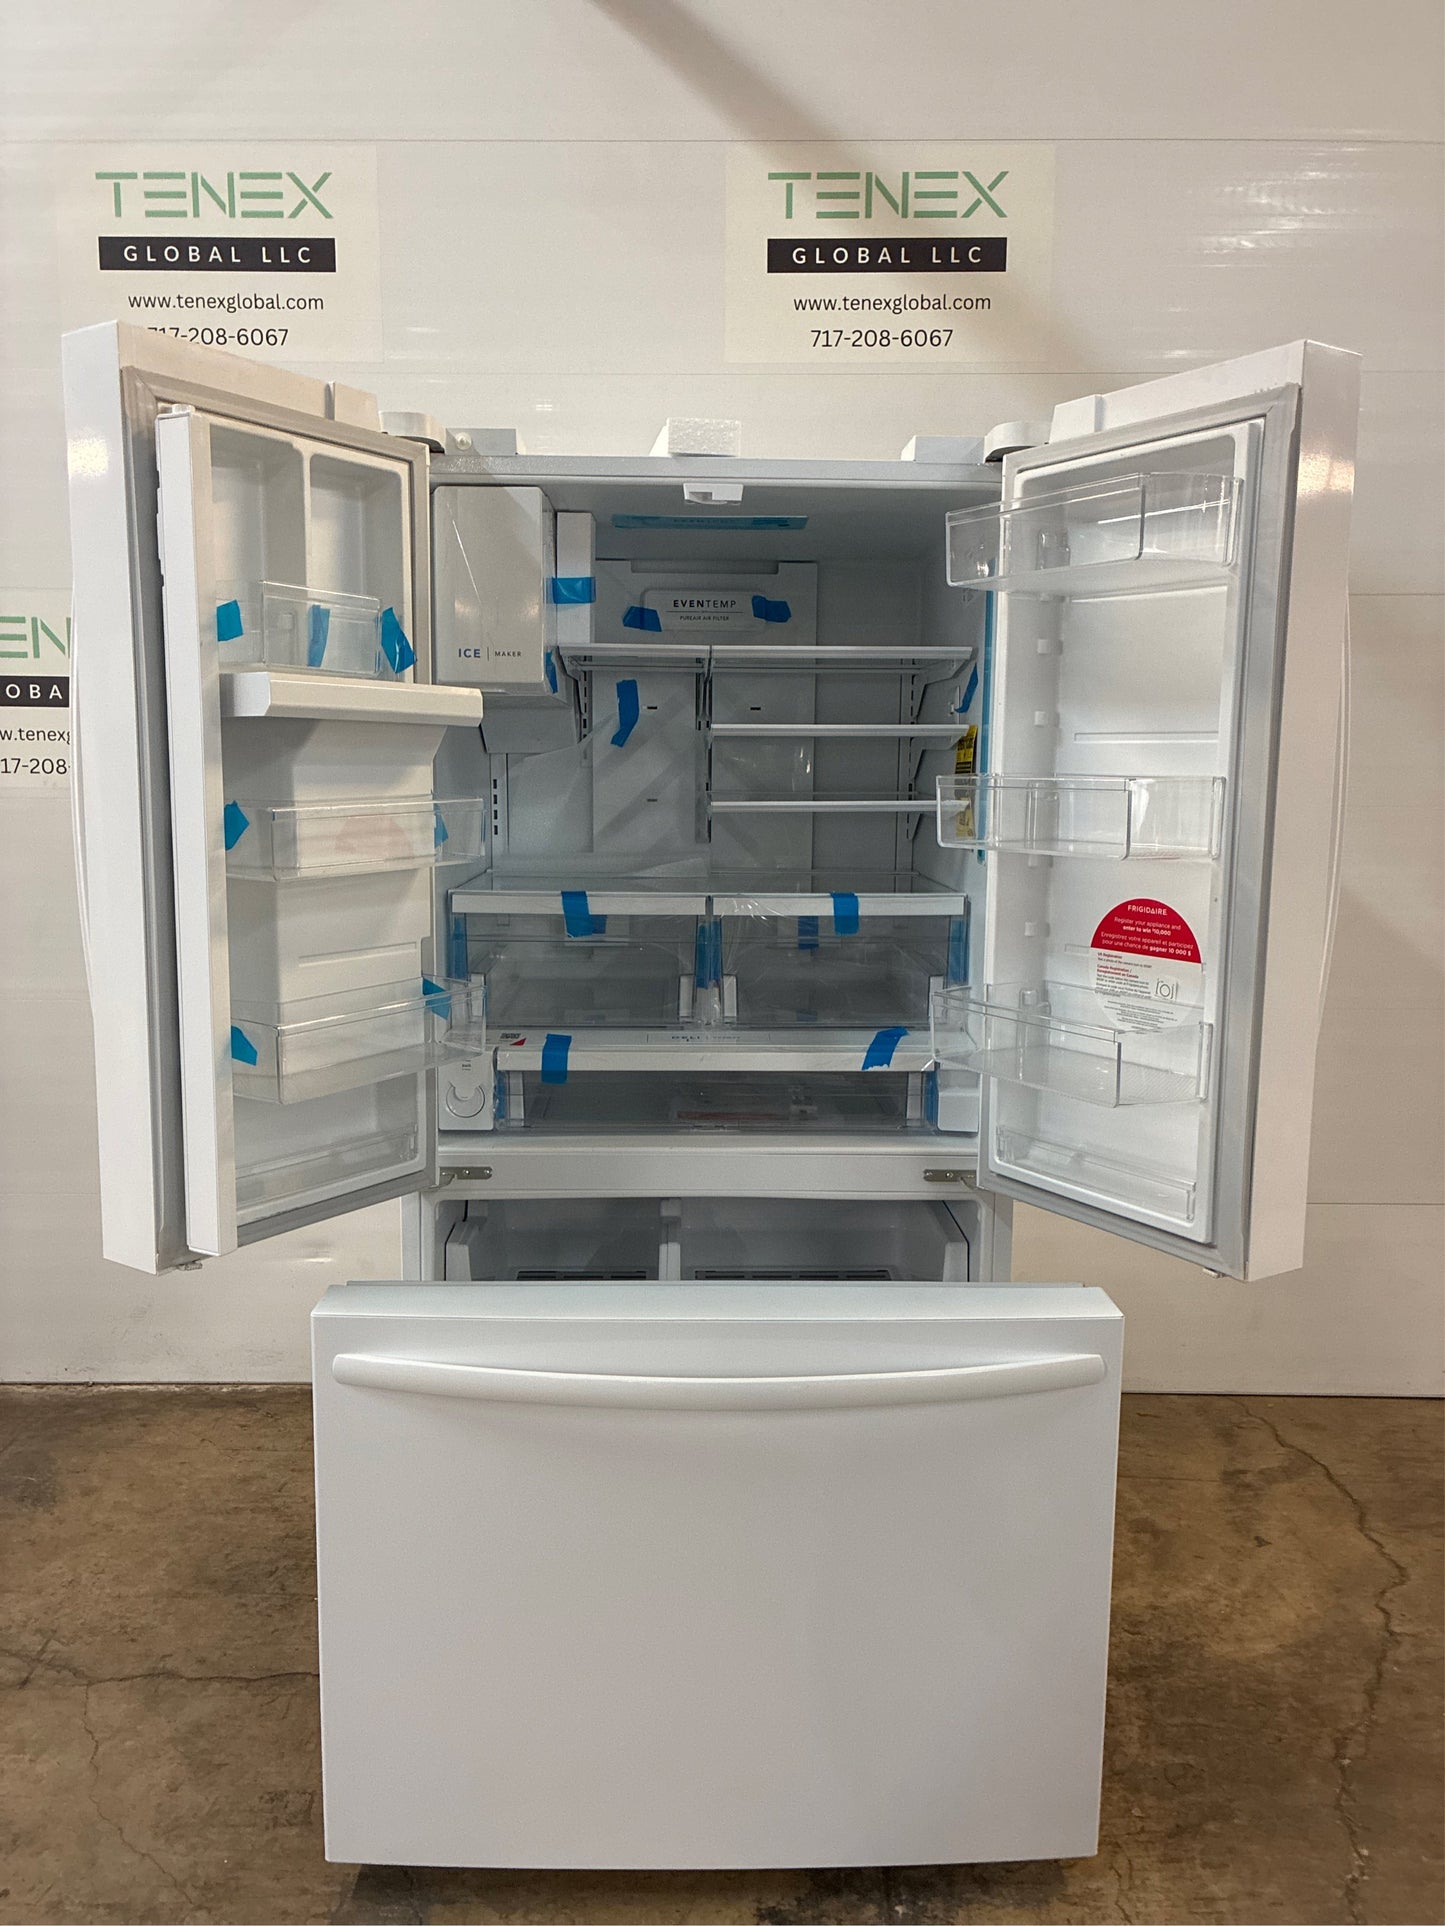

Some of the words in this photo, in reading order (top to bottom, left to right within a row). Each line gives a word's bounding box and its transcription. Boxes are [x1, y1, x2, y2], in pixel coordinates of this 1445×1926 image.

[95, 172, 333, 218] TENEX
[768, 171, 1009, 219] TENEX
[124, 245, 241, 263] GLOBAL
[261, 246, 311, 264] LLC
[792, 247, 911, 264] GLOBAL
[931, 246, 982, 263] LLC
[128, 293, 325, 314] www.tenexglobal.com
[793, 293, 992, 315] www.tenexglobal.com
[147, 327, 289, 346] 7-208-6067
[810, 329, 954, 347] 717-208-6067
[673, 599, 737, 608] EVENTEMP
[458, 648, 481, 658] ICE
[1127, 904, 1168, 916] FRIGIDAIRE
[1114, 916, 1134, 924] Register
[1134, 919, 1146, 927] your
[1146, 921, 1170, 930] appliance
[1100, 931, 1127, 940] Enregistrez
[1168, 941, 1193, 950] participez
